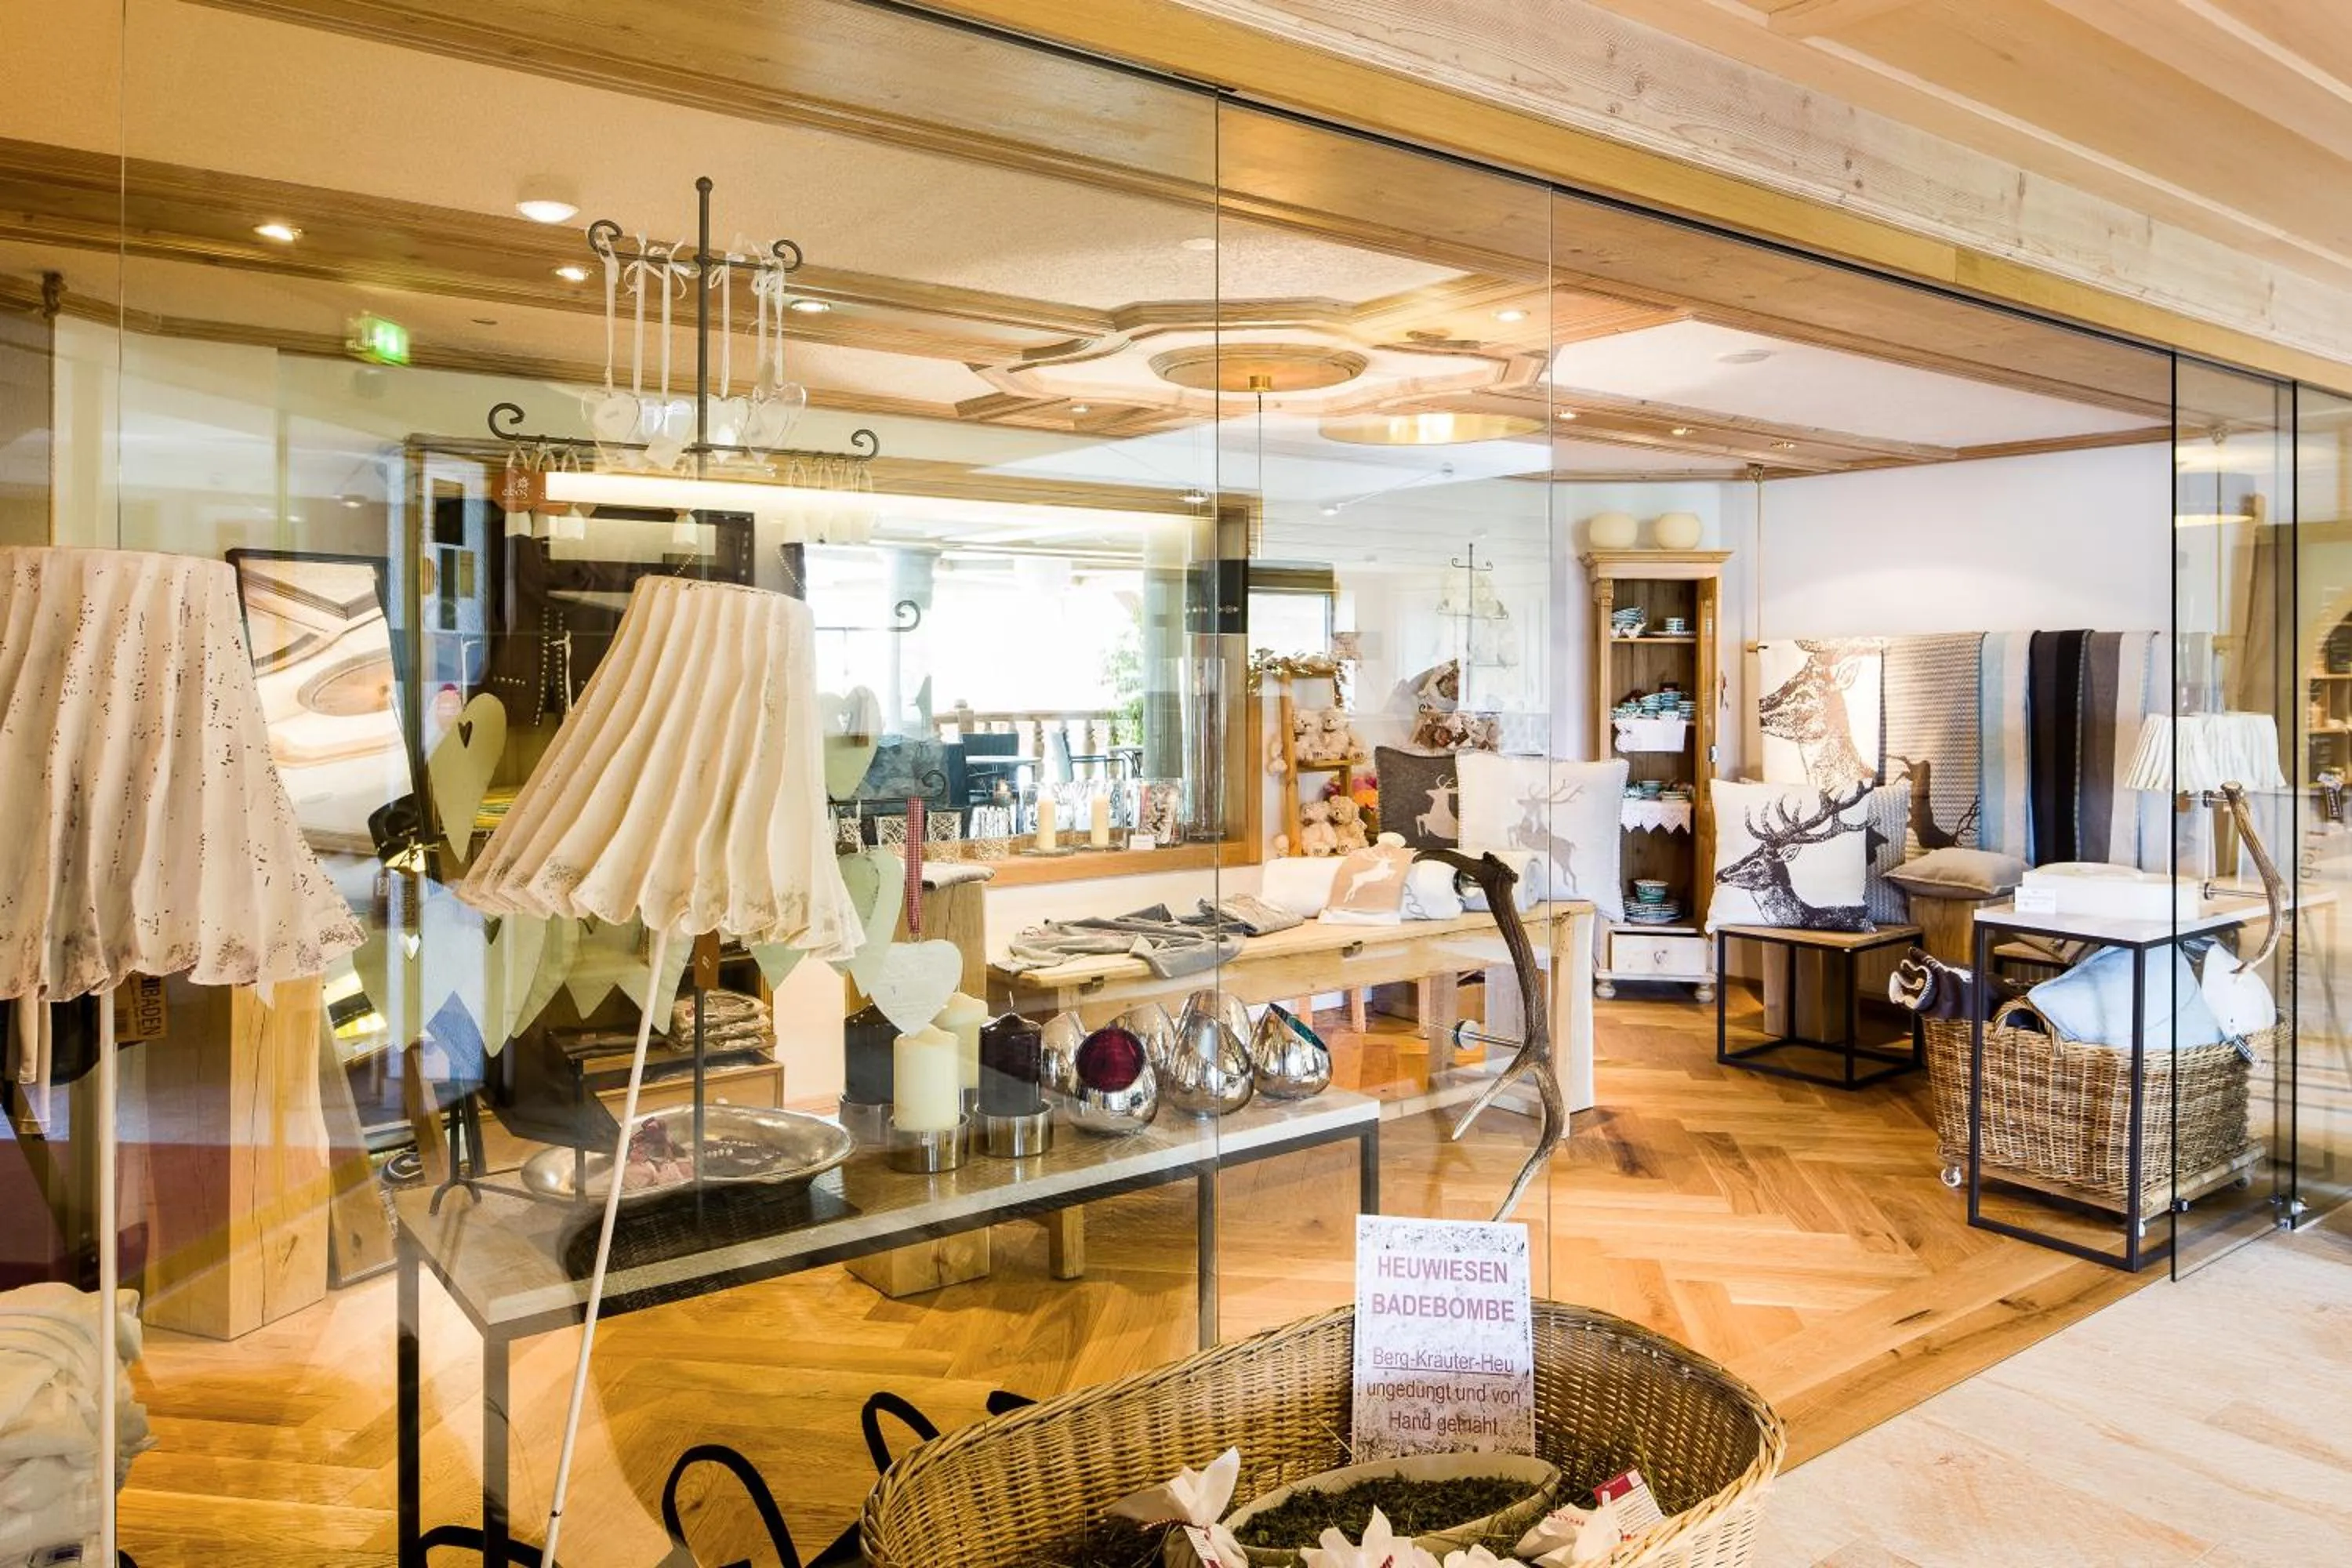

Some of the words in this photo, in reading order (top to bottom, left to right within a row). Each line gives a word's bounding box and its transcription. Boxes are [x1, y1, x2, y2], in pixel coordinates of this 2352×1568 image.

[1377, 1255, 1508, 1283] HEUWIESEN
[1372, 1293, 1515, 1322] BADEBOMBE
[1455, 1383, 1486, 1403] und
[1492, 1389, 1520, 1404] von
[1388, 1410, 1431, 1431] Hand
